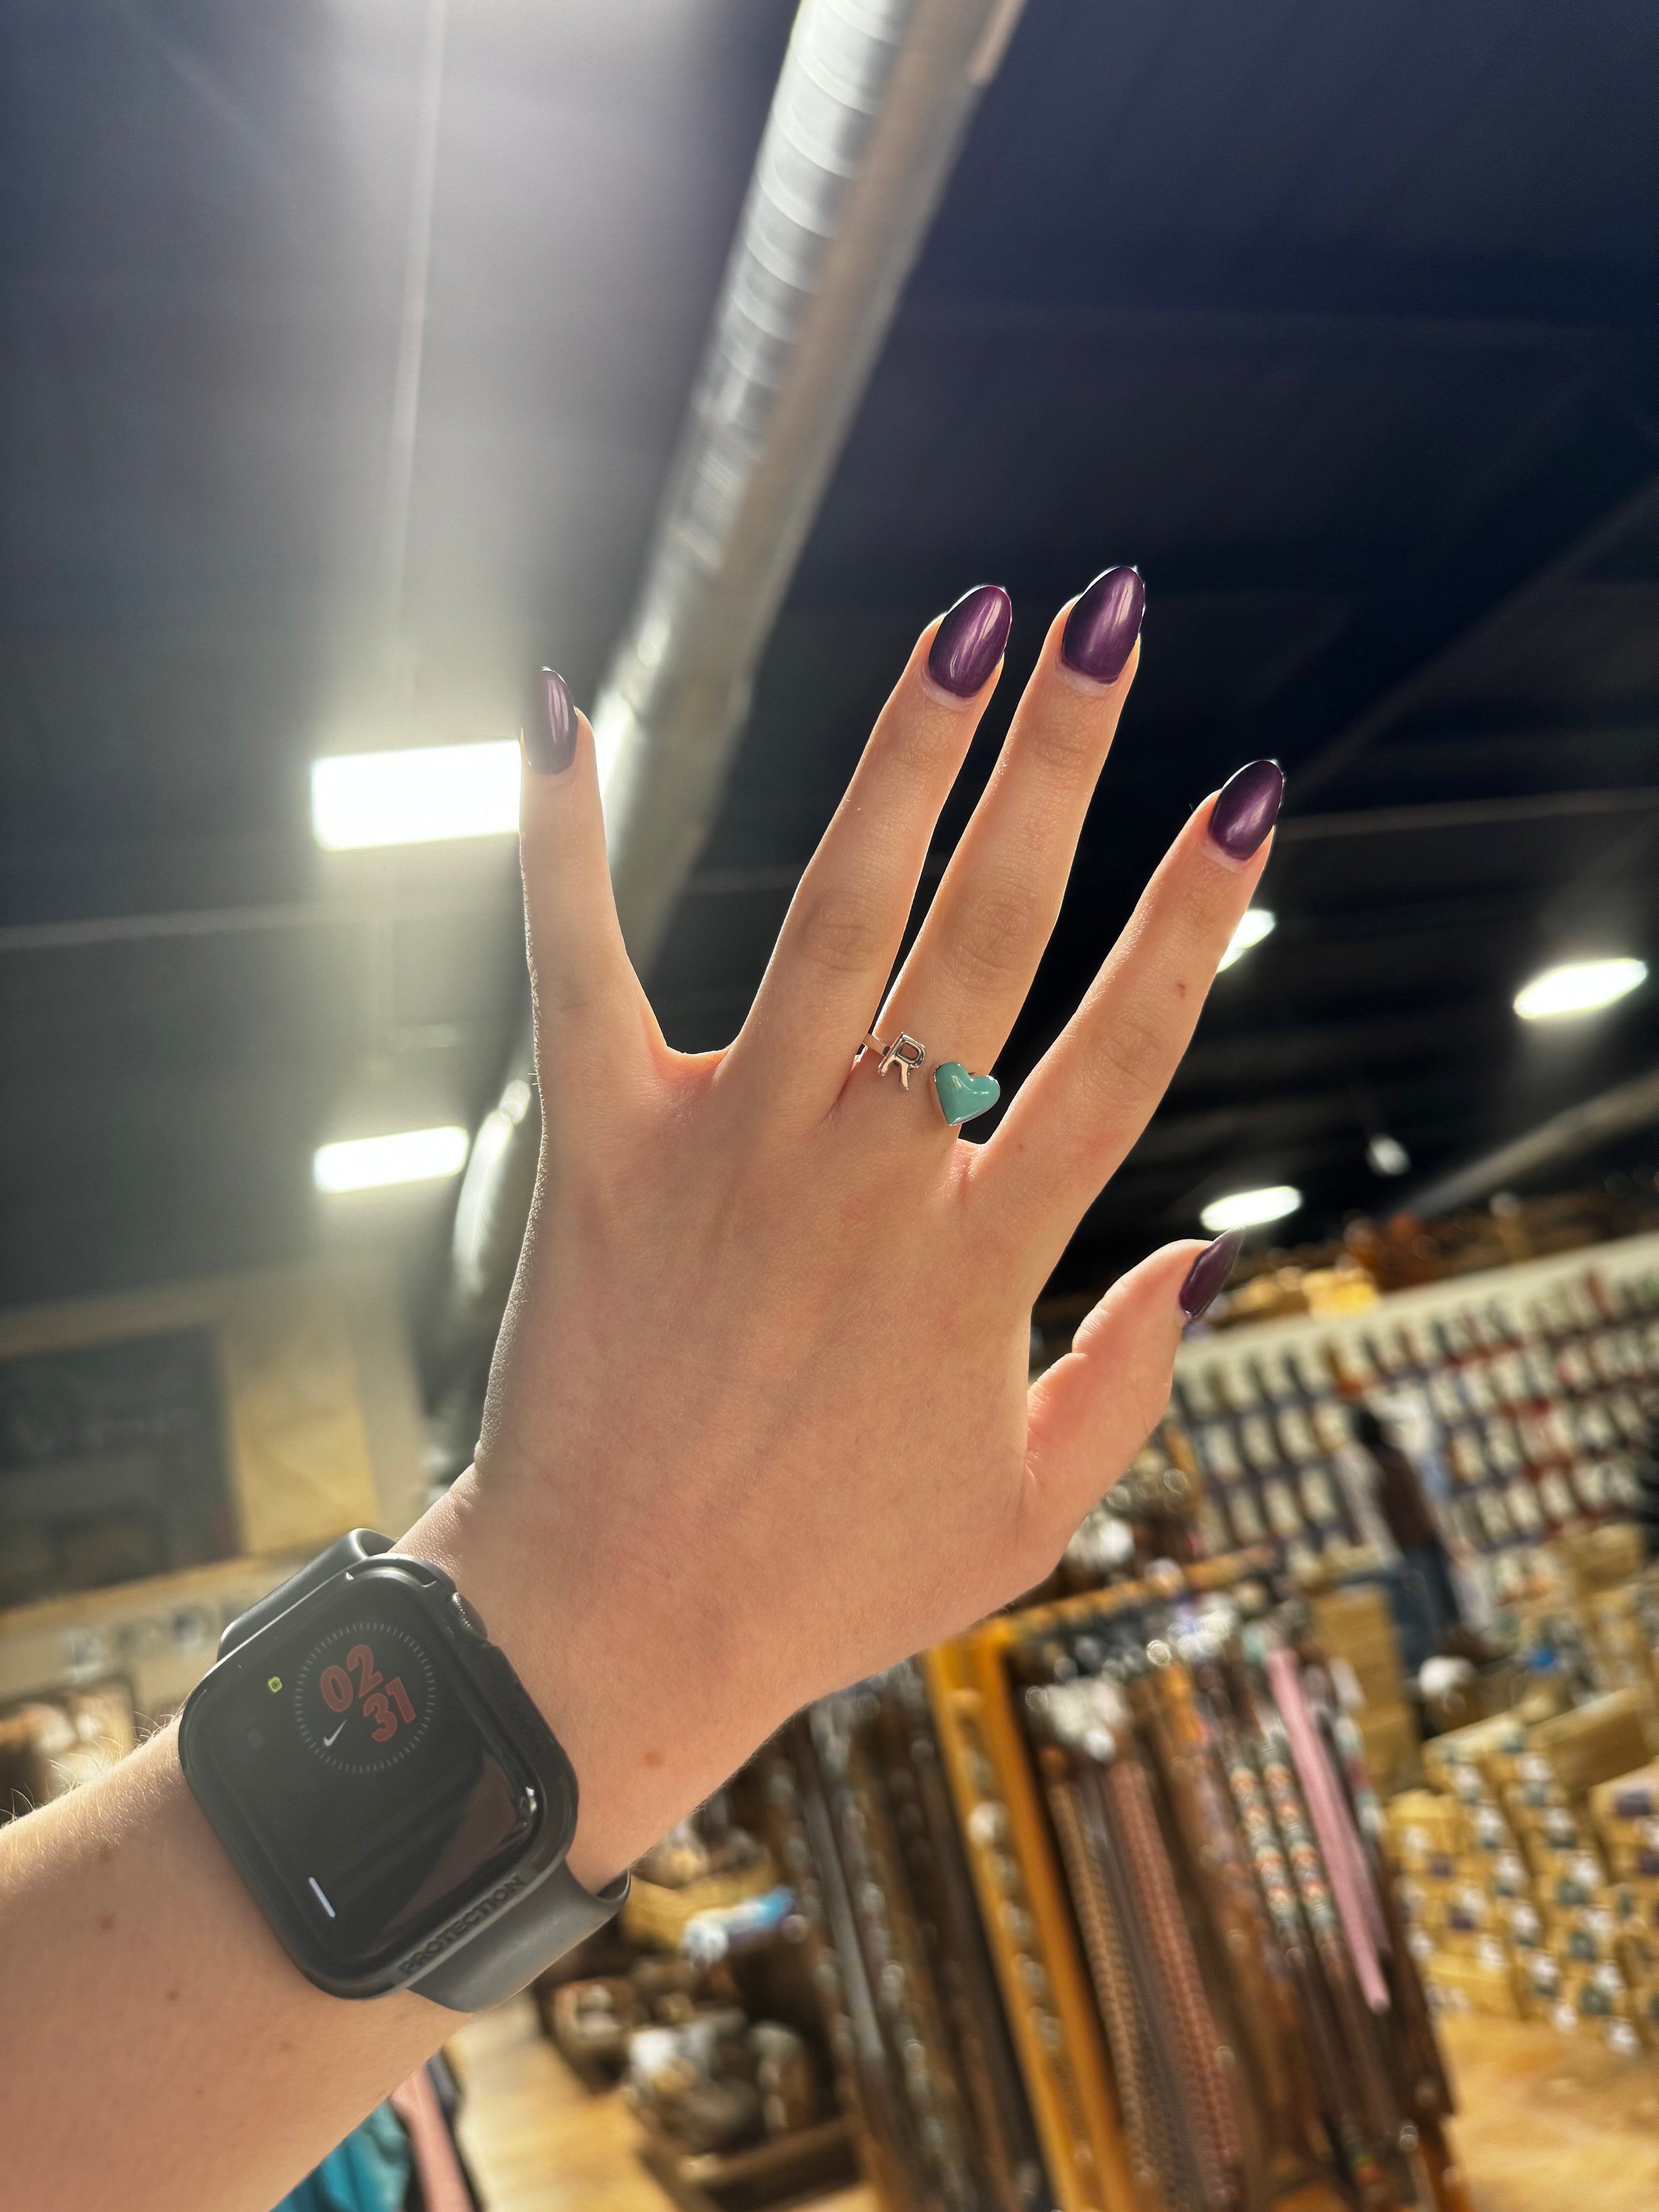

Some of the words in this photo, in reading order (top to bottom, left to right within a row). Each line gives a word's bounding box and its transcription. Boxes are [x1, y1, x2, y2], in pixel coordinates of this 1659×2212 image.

[878, 1032, 925, 1090] R
[319, 1644, 383, 1713] 02
[363, 1677, 416, 1742] 31
[398, 1875, 526, 1975] PROTECTION
